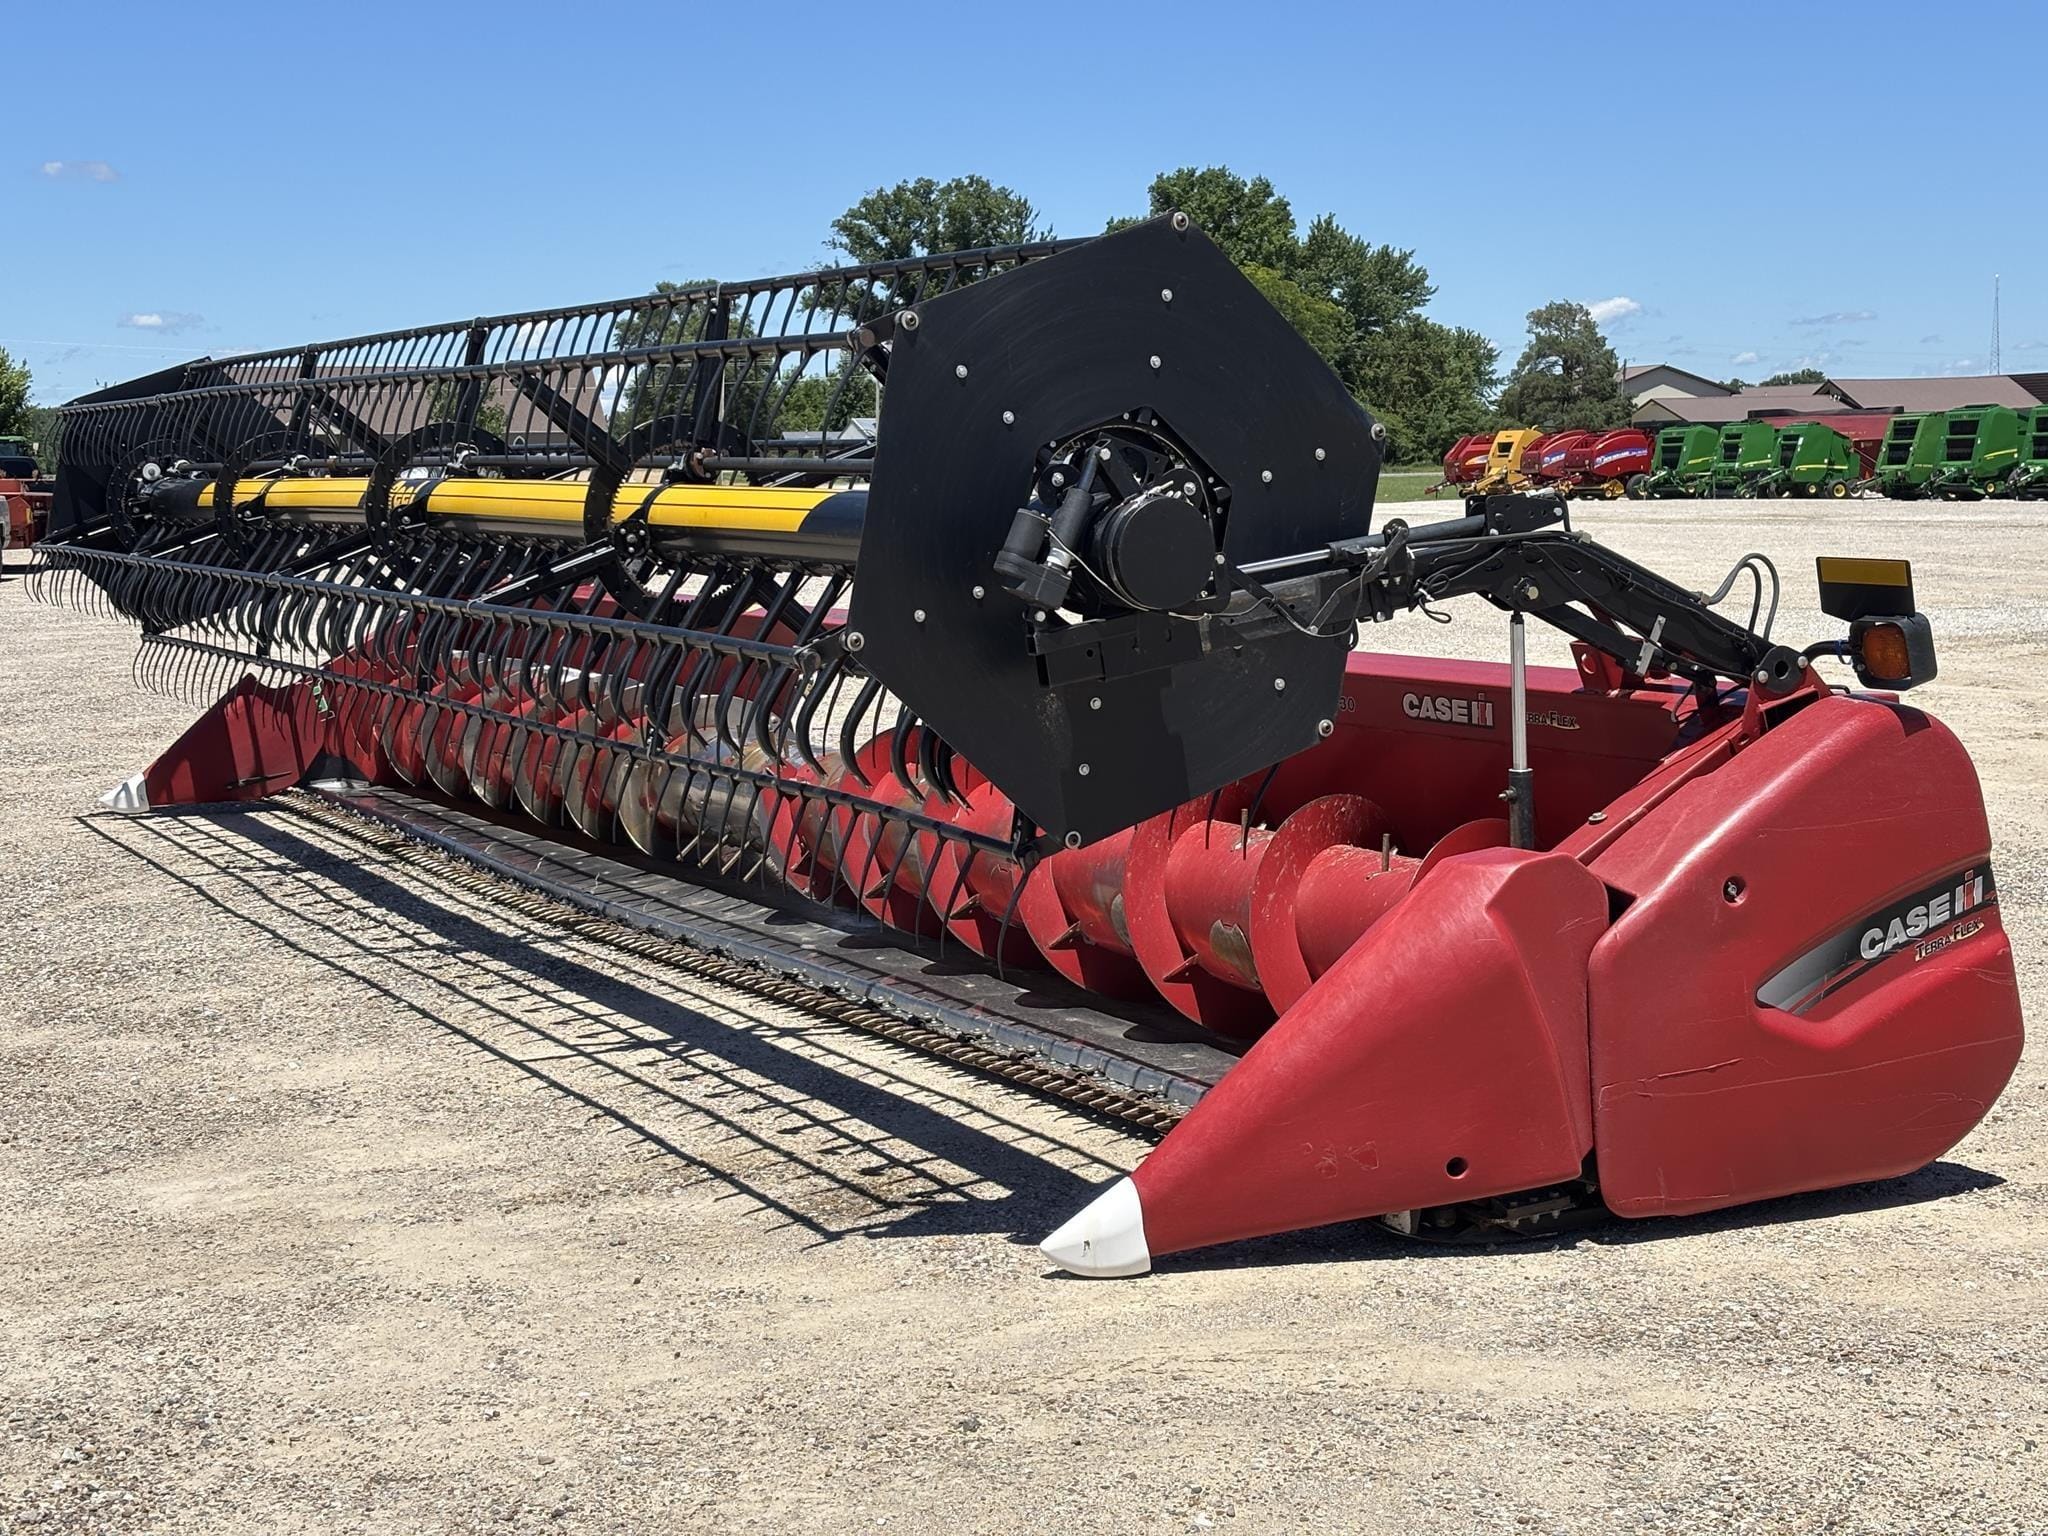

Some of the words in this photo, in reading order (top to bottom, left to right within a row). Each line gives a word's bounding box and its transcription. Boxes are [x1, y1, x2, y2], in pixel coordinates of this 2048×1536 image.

[1403, 693, 1468, 723] CASE
[1860, 891, 1950, 959] CASE
[1915, 936, 1951, 960] TERRA
[1953, 917, 1980, 940] FLEX
